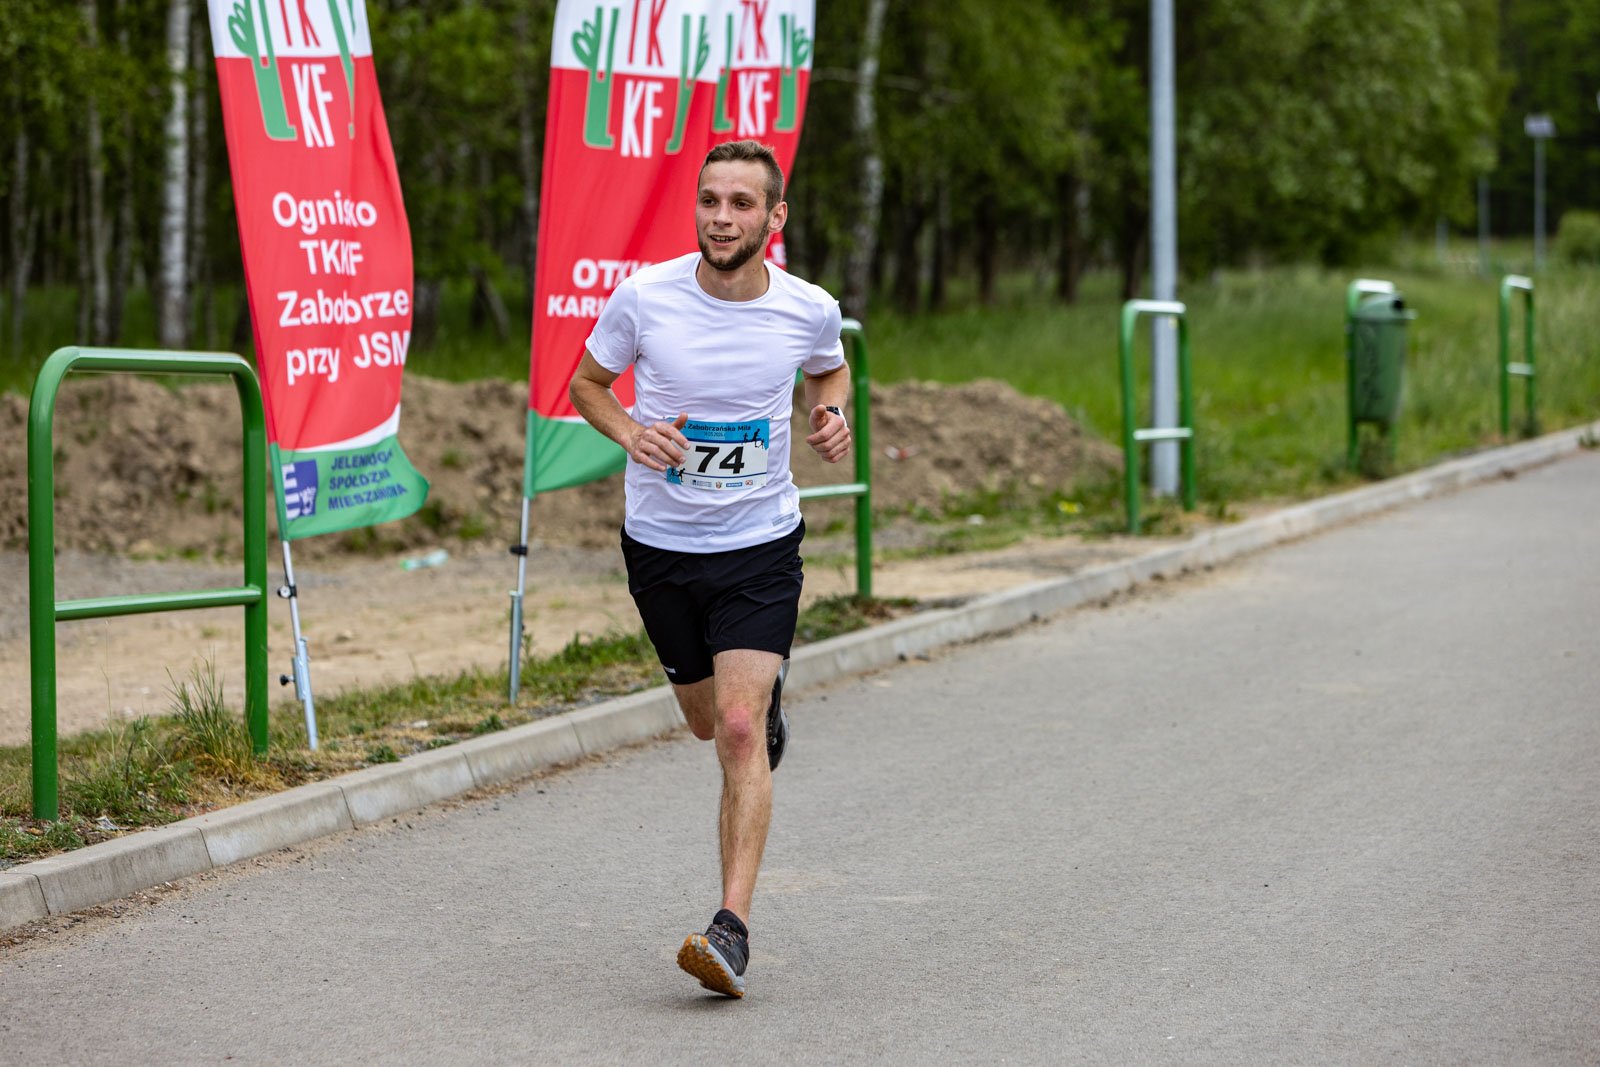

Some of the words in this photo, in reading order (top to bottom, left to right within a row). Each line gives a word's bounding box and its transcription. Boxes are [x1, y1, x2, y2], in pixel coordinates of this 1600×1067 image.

[291, 63, 335, 148] KF
[621, 79, 664, 158] KF
[737, 72, 773, 137] KF
[277, 287, 410, 328] Zabobrze
[285, 346, 340, 386] przy
[688, 423, 736, 432] Zabobrzańska
[695, 445, 745, 474] 74
